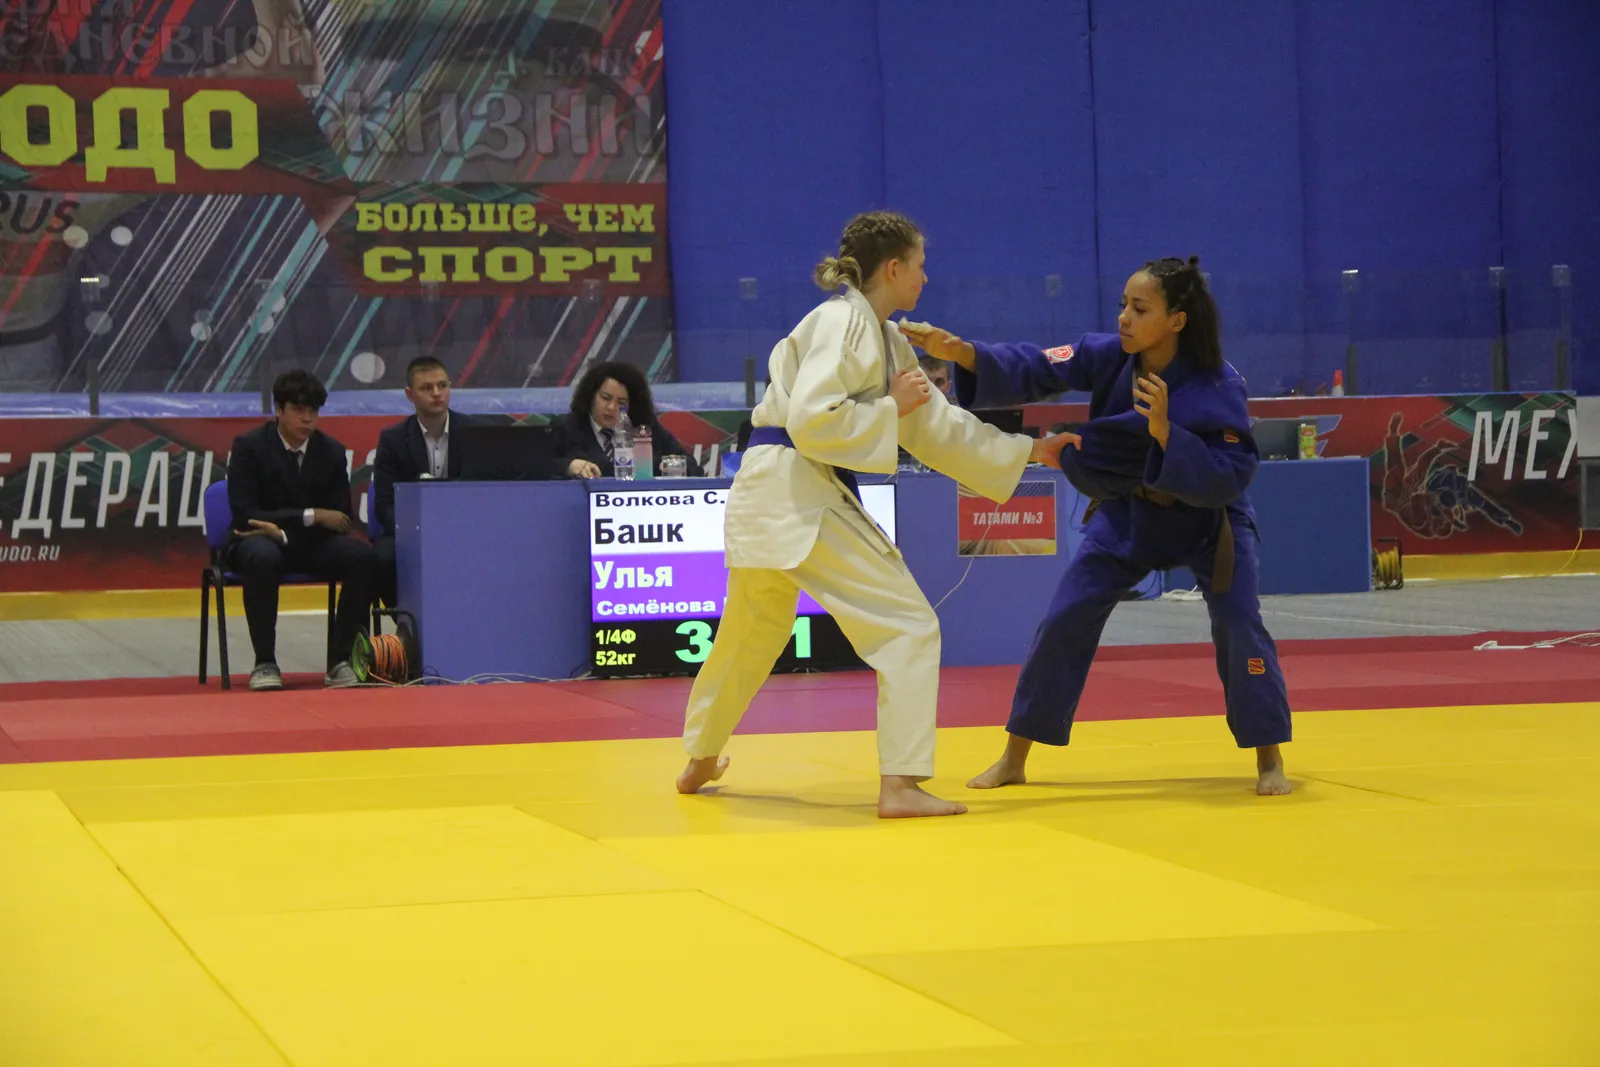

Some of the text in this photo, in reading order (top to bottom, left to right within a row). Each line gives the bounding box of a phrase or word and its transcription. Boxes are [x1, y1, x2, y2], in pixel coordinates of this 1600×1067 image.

[563, 203, 655, 232] ЧЕМ
[363, 246, 652, 283] СПОРТ
[595, 493, 695, 508] Волкова
[973, 511, 1044, 525] ТАТАМИ №3
[593, 517, 685, 545] Башк
[593, 560, 673, 590] Улья
[596, 598, 716, 617] Семёнова
[594, 628, 637, 646] 1/4Ф
[674, 619, 714, 664] 3
[594, 650, 637, 667] 52кг
